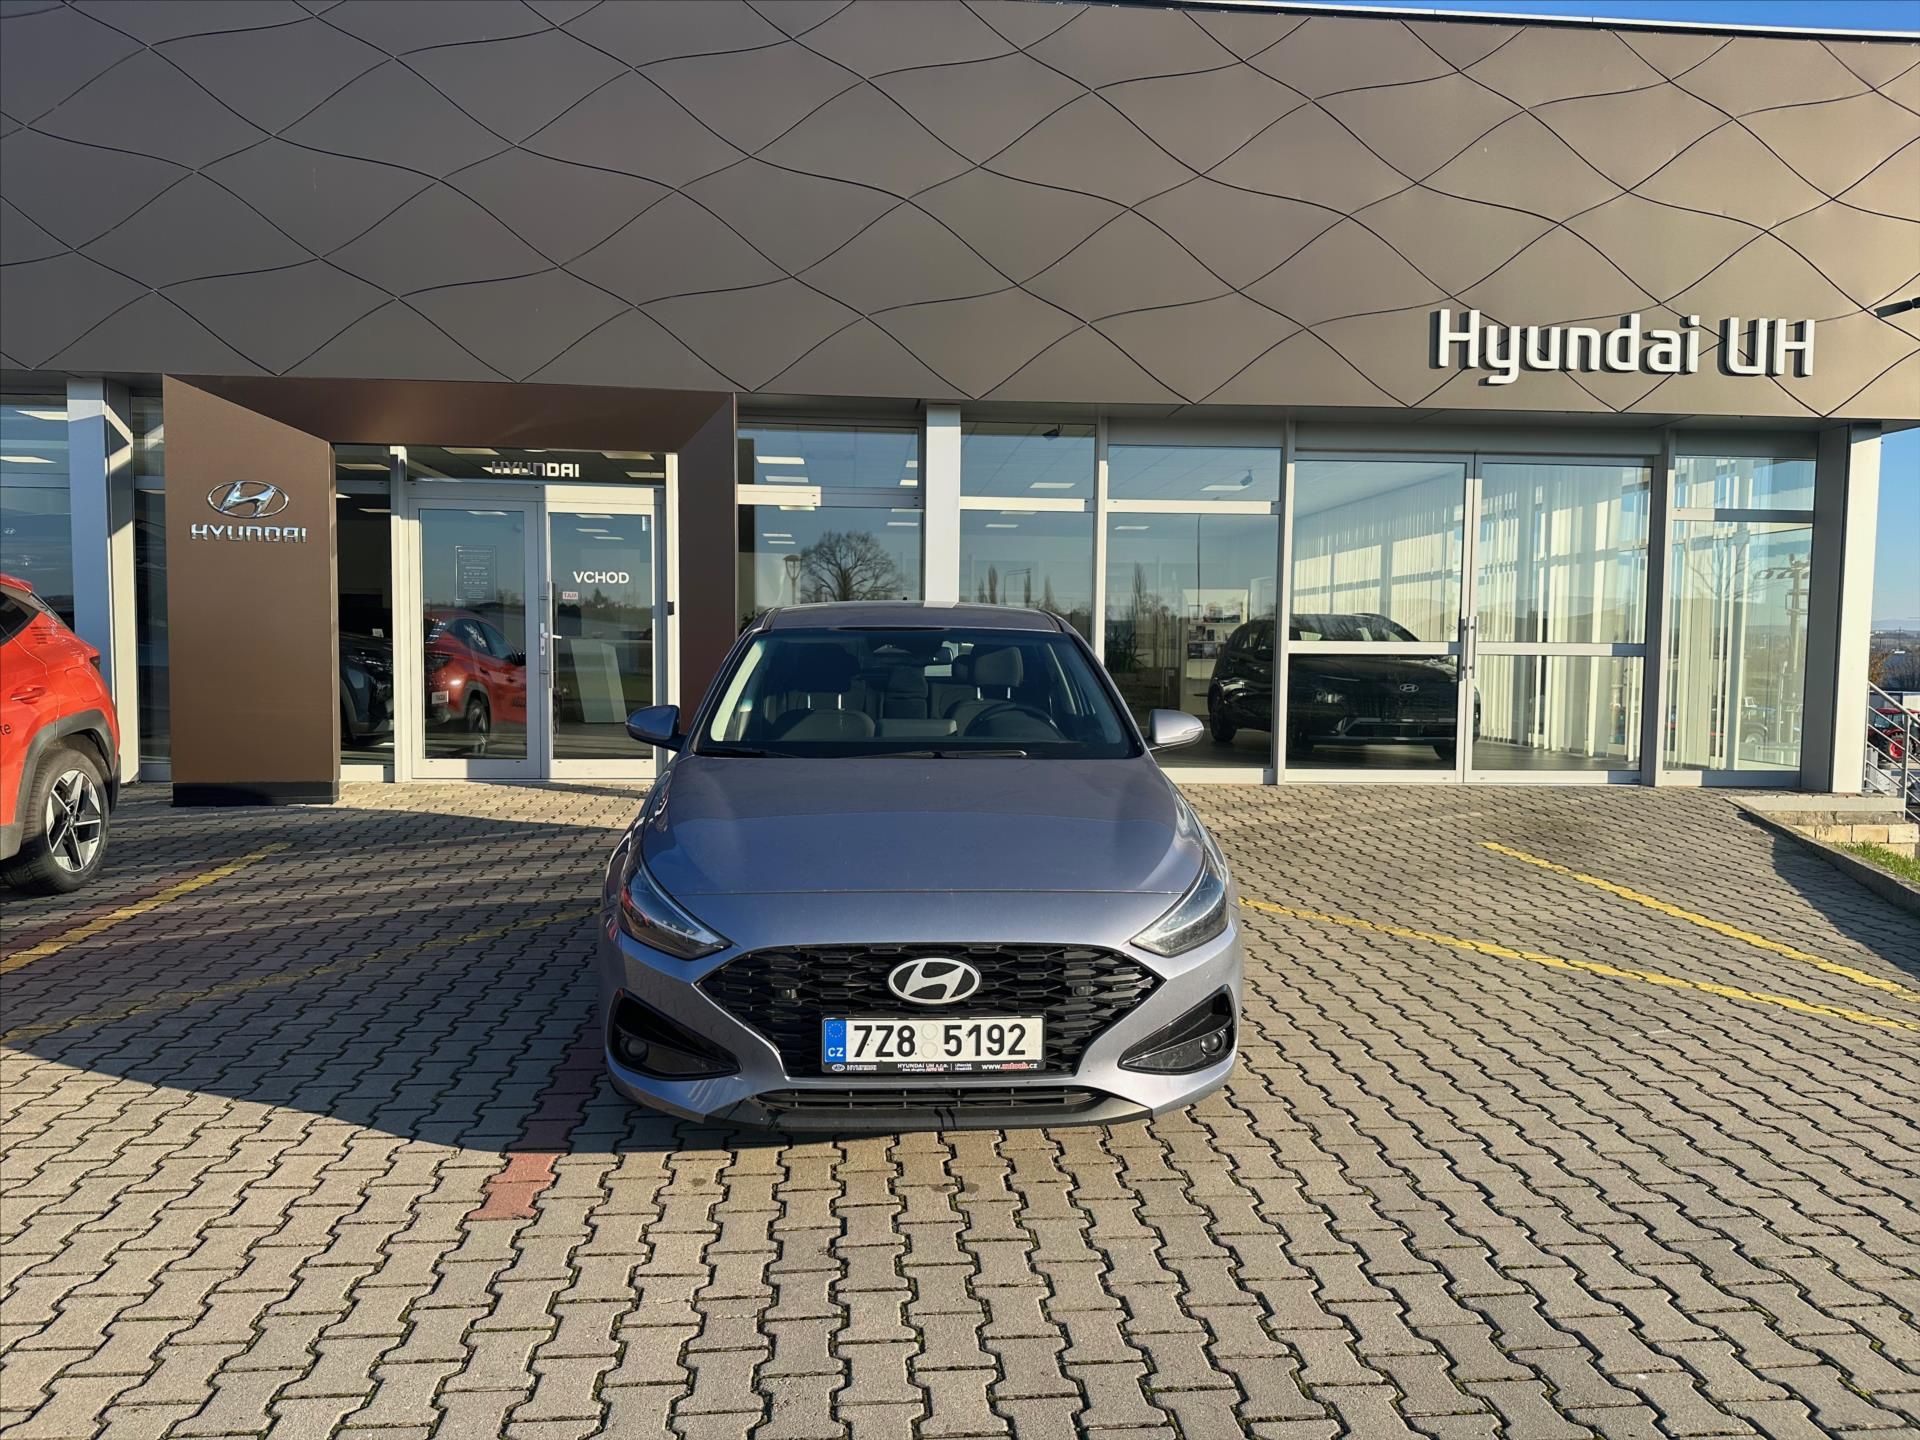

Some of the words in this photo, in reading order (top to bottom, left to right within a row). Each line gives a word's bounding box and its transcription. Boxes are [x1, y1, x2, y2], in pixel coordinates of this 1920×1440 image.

[1436, 308, 1699, 384] Hyundai
[1725, 316, 1816, 376] UH
[490, 460, 580, 478] HYUNDAI
[190, 522, 307, 543] HYUNDAI
[572, 570, 630, 584] VCHOD
[853, 1024, 916, 1058] 7Z8
[943, 1023, 1026, 1057] 5192
[827, 1047, 844, 1057] CZ
